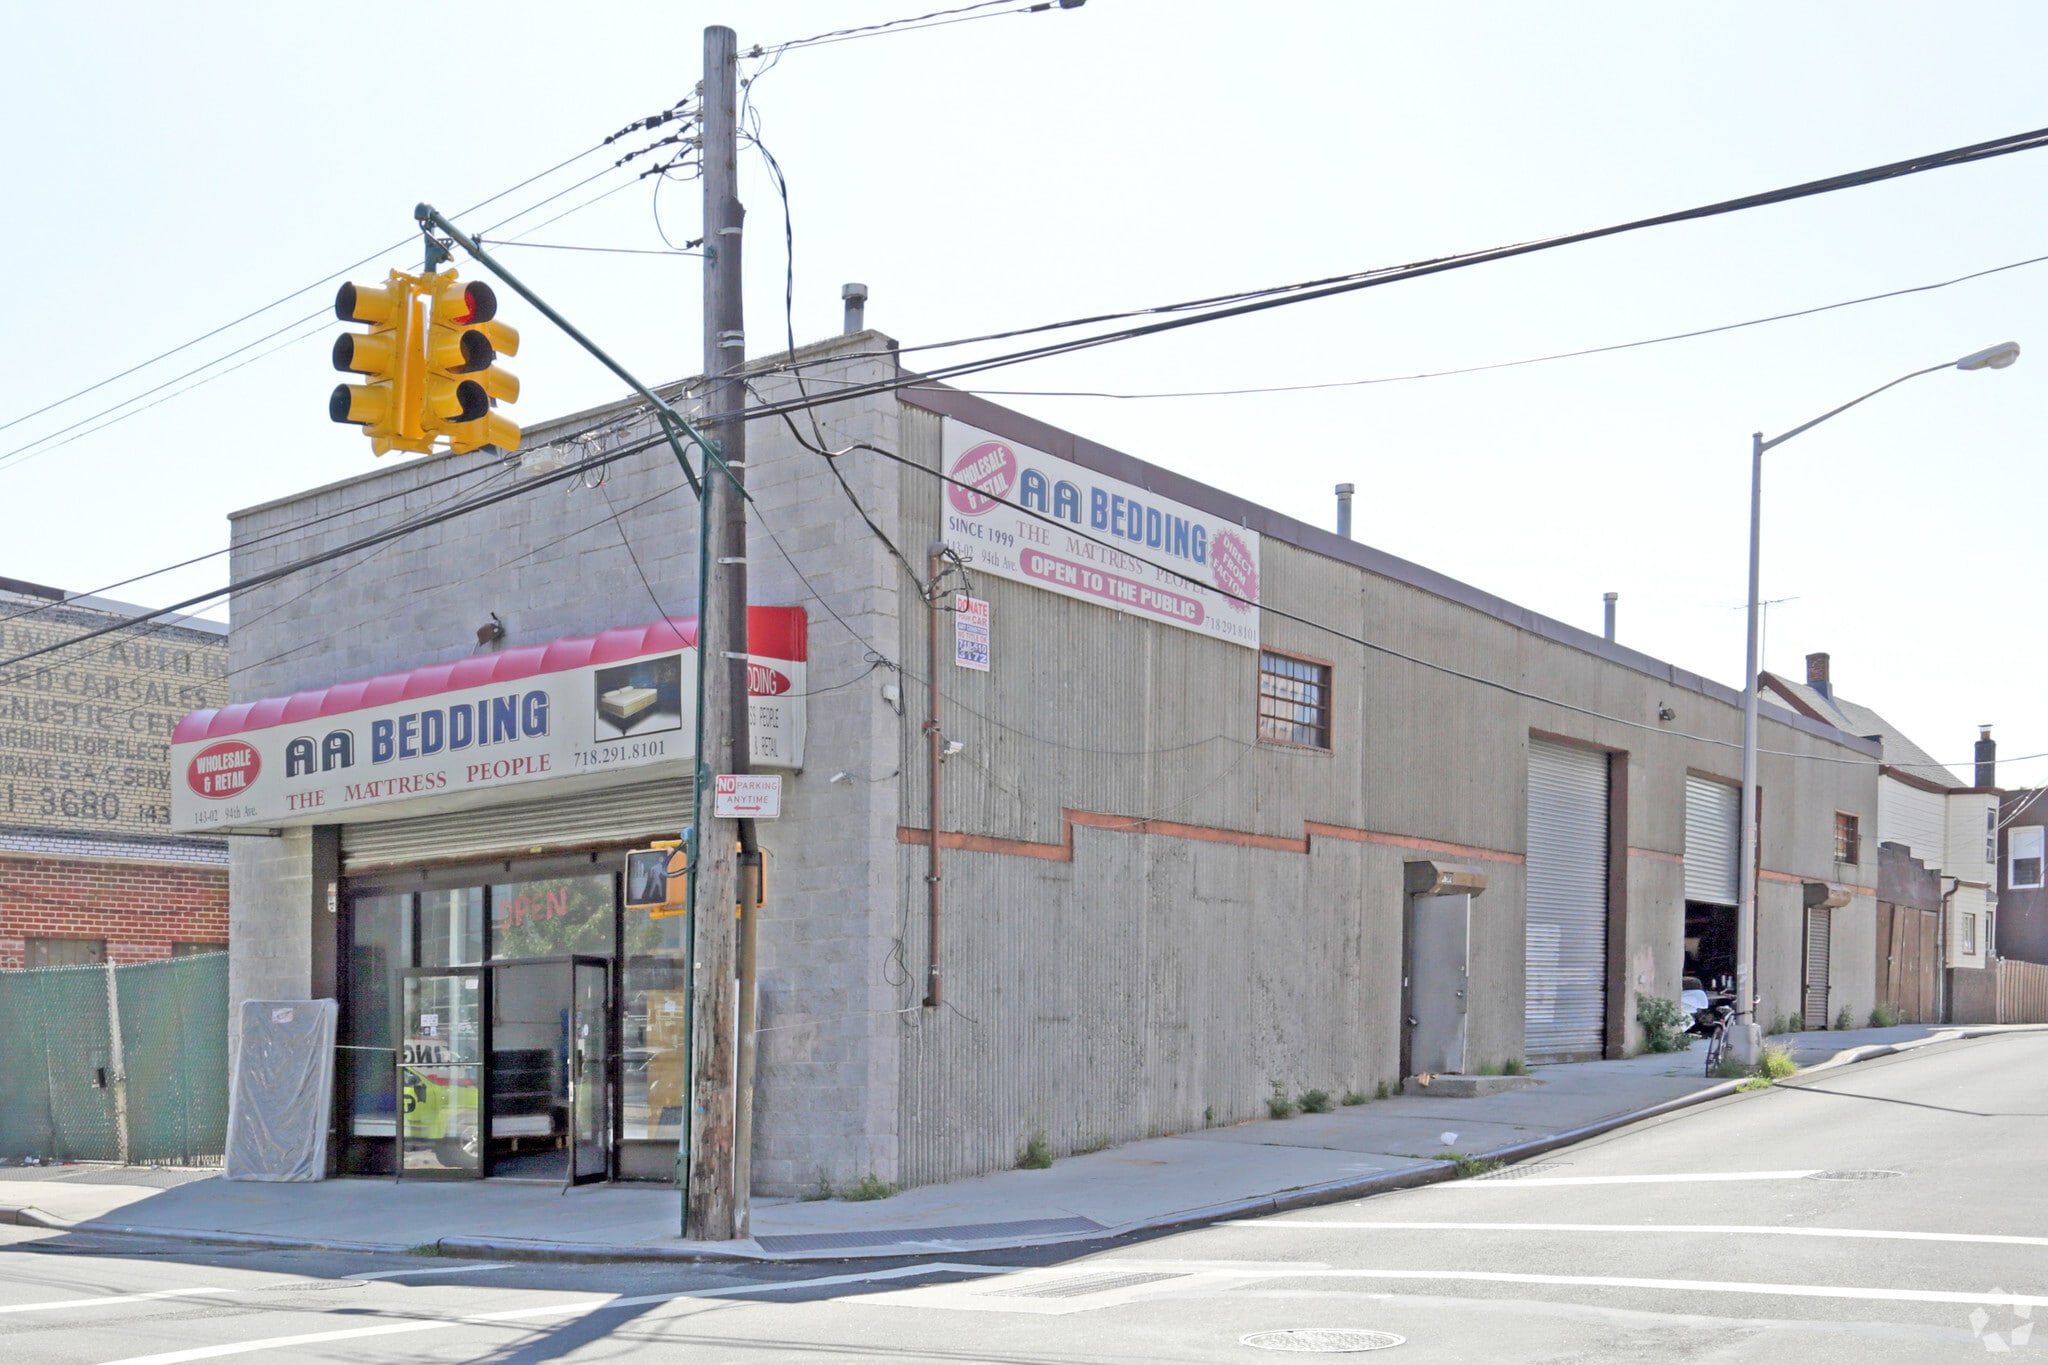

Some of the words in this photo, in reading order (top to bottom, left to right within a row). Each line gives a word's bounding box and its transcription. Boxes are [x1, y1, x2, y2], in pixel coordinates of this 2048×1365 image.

[953, 447, 1007, 492] WHOLESALE
[978, 472, 1010, 504] RETAIL
[949, 516, 983, 539] SINCE
[988, 528, 1014, 548] 1999
[1091, 486, 1208, 566] BEDDING
[981, 549, 1000, 567] 94th
[1016, 520, 1050, 546] THE
[1066, 537, 1143, 575] MATTRESS
[1156, 568, 1208, 595] PEOPLE
[1223, 536, 1252, 575] DIRECT
[1223, 553, 1246, 586] FROM
[1031, 555, 1077, 584] OPEN
[1082, 570, 1103, 591] TO
[1108, 578, 1137, 601] THE
[1140, 588, 1196, 619] PUBLIC
[957, 597, 988, 617] DONATE
[972, 615, 987, 626] CAR
[107, 641, 191, 674] AUTO
[64, 671, 121, 700] CAR
[129, 679, 208, 710] SALES
[286, 729, 355, 778] AA
[372, 690, 551, 765] BEDDING
[196, 749, 251, 774] WHOLESALE
[574, 740, 665, 767] 718.291.8101
[203, 776, 212, 793] &
[215, 770, 247, 791] RETAIL
[286, 790, 326, 811] THE
[344, 771, 447, 801] MATTRESS
[466, 754, 552, 783] PEOPLE
[718, 777, 736, 793] NO
[736, 782, 777, 791] PARKING
[194, 809, 218, 824] 143-02
[224, 804, 241, 819] 94th
[243, 804, 258, 818] Ave.
[727, 795, 769, 804] ANYTIME
[498, 886, 567, 929] OPEN
